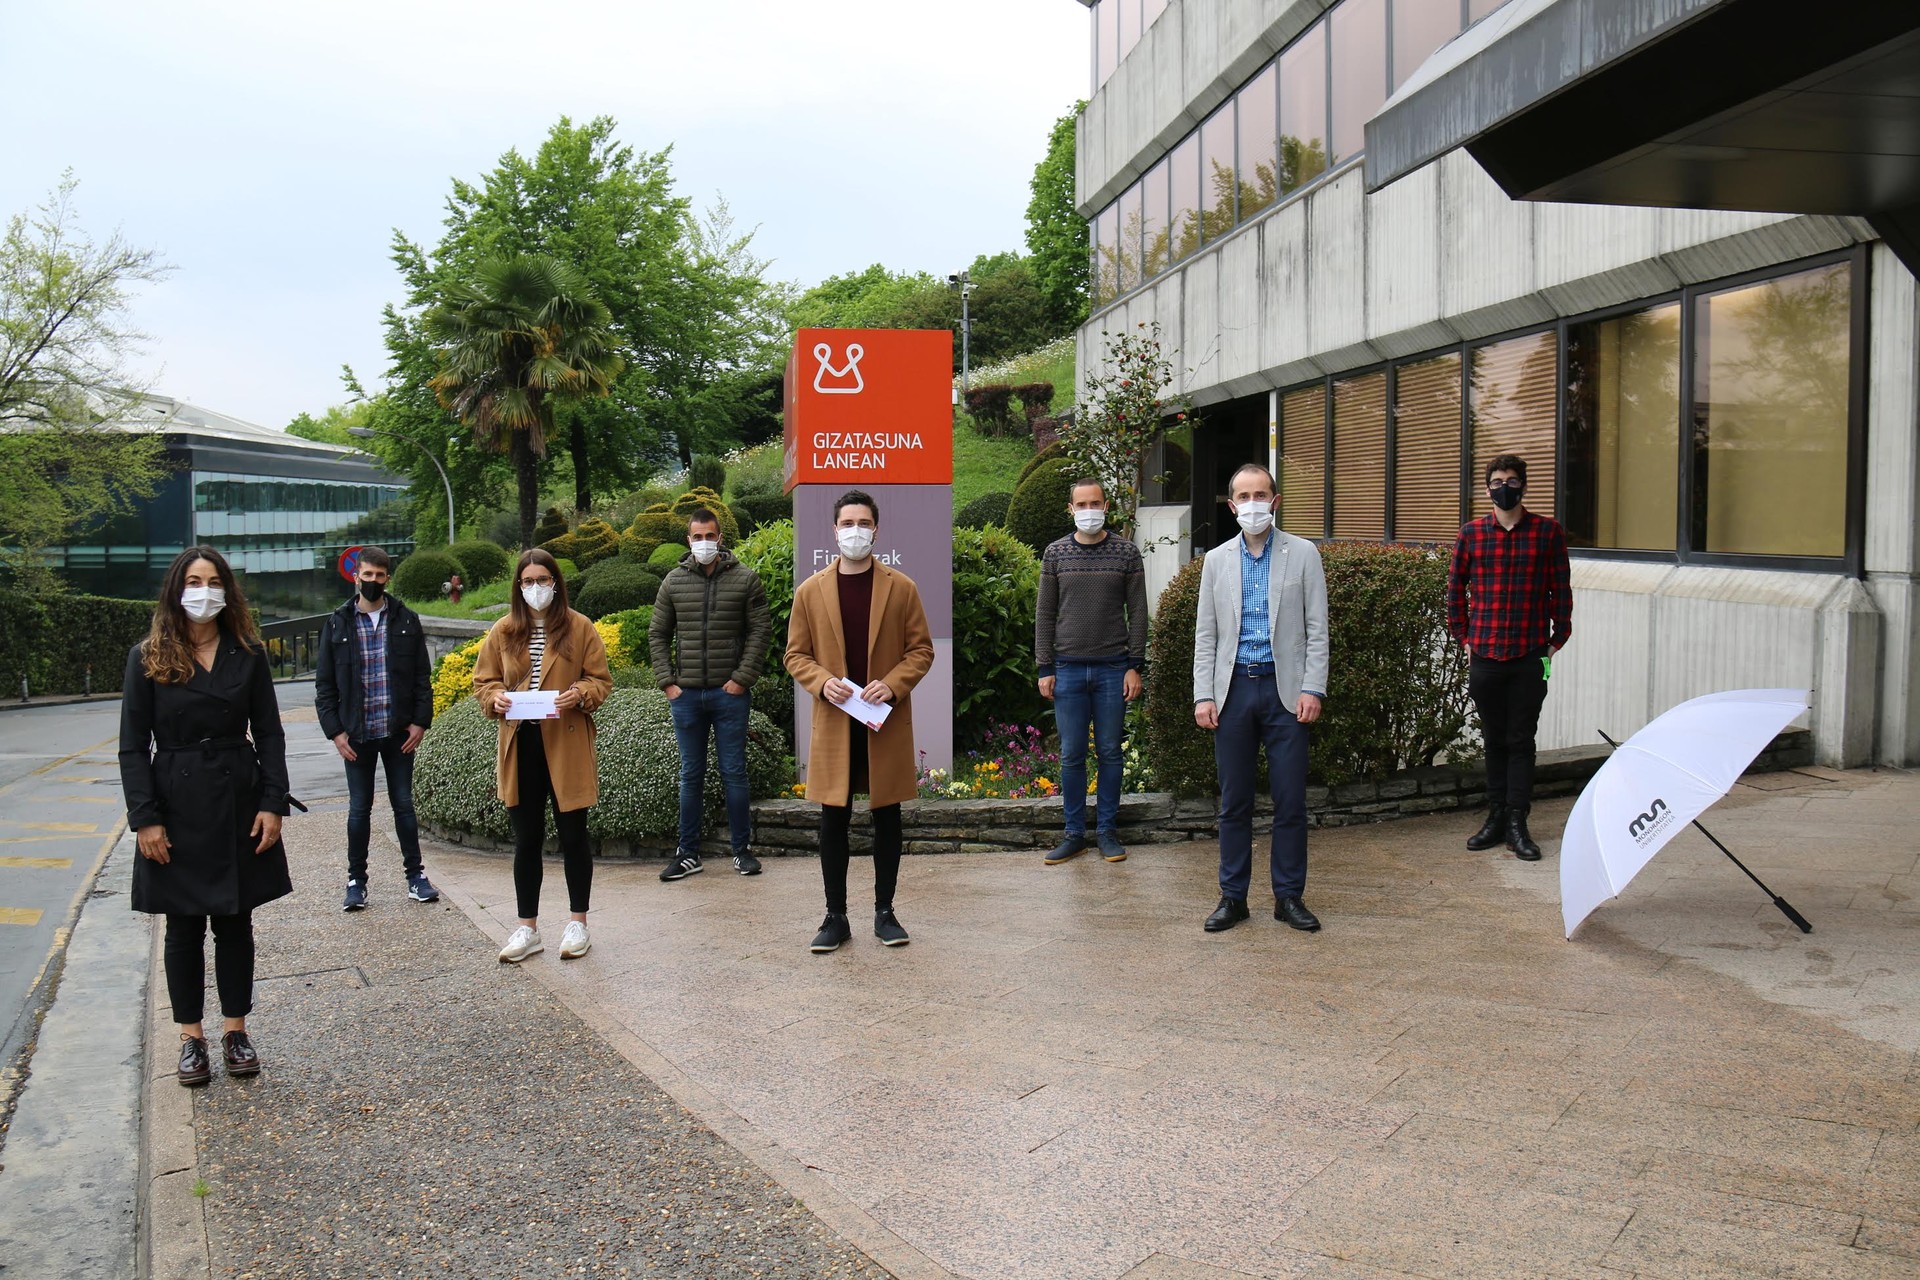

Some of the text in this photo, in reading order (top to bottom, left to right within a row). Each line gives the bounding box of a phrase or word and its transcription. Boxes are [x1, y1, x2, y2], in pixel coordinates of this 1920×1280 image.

[813, 432, 923, 449] GIZATASUNA
[813, 452, 885, 469] LANEAN
[813, 549, 902, 566] Finzak
[1635, 808, 1672, 844] MONDRAGON
